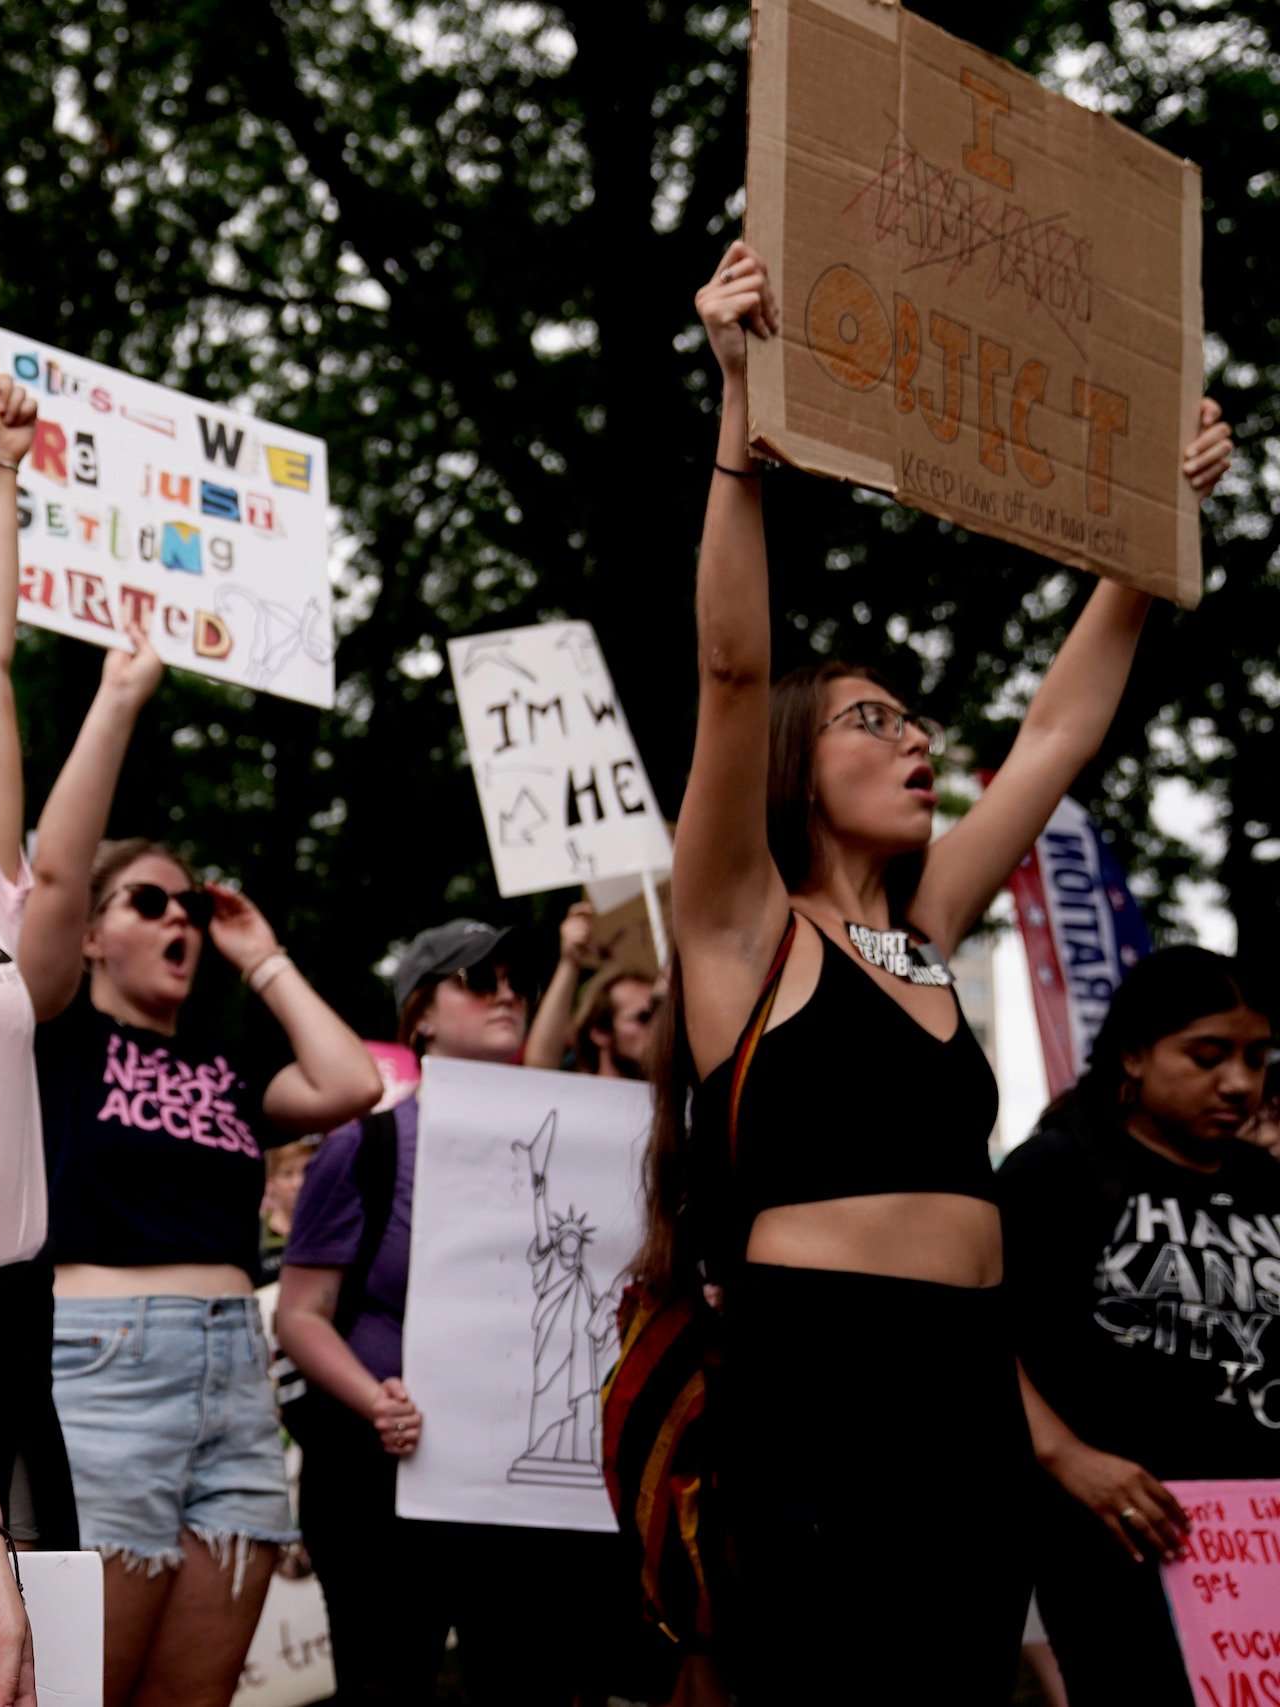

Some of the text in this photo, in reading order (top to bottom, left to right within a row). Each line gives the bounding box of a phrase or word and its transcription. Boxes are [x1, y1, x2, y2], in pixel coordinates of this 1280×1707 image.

[960, 67, 1014, 193] I
[805, 263, 1129, 517] OBJECT
[487, 689, 567, 753] I'M
[97, 1087, 261, 1159] ACCESS
[1192, 1571, 1240, 1604] get
